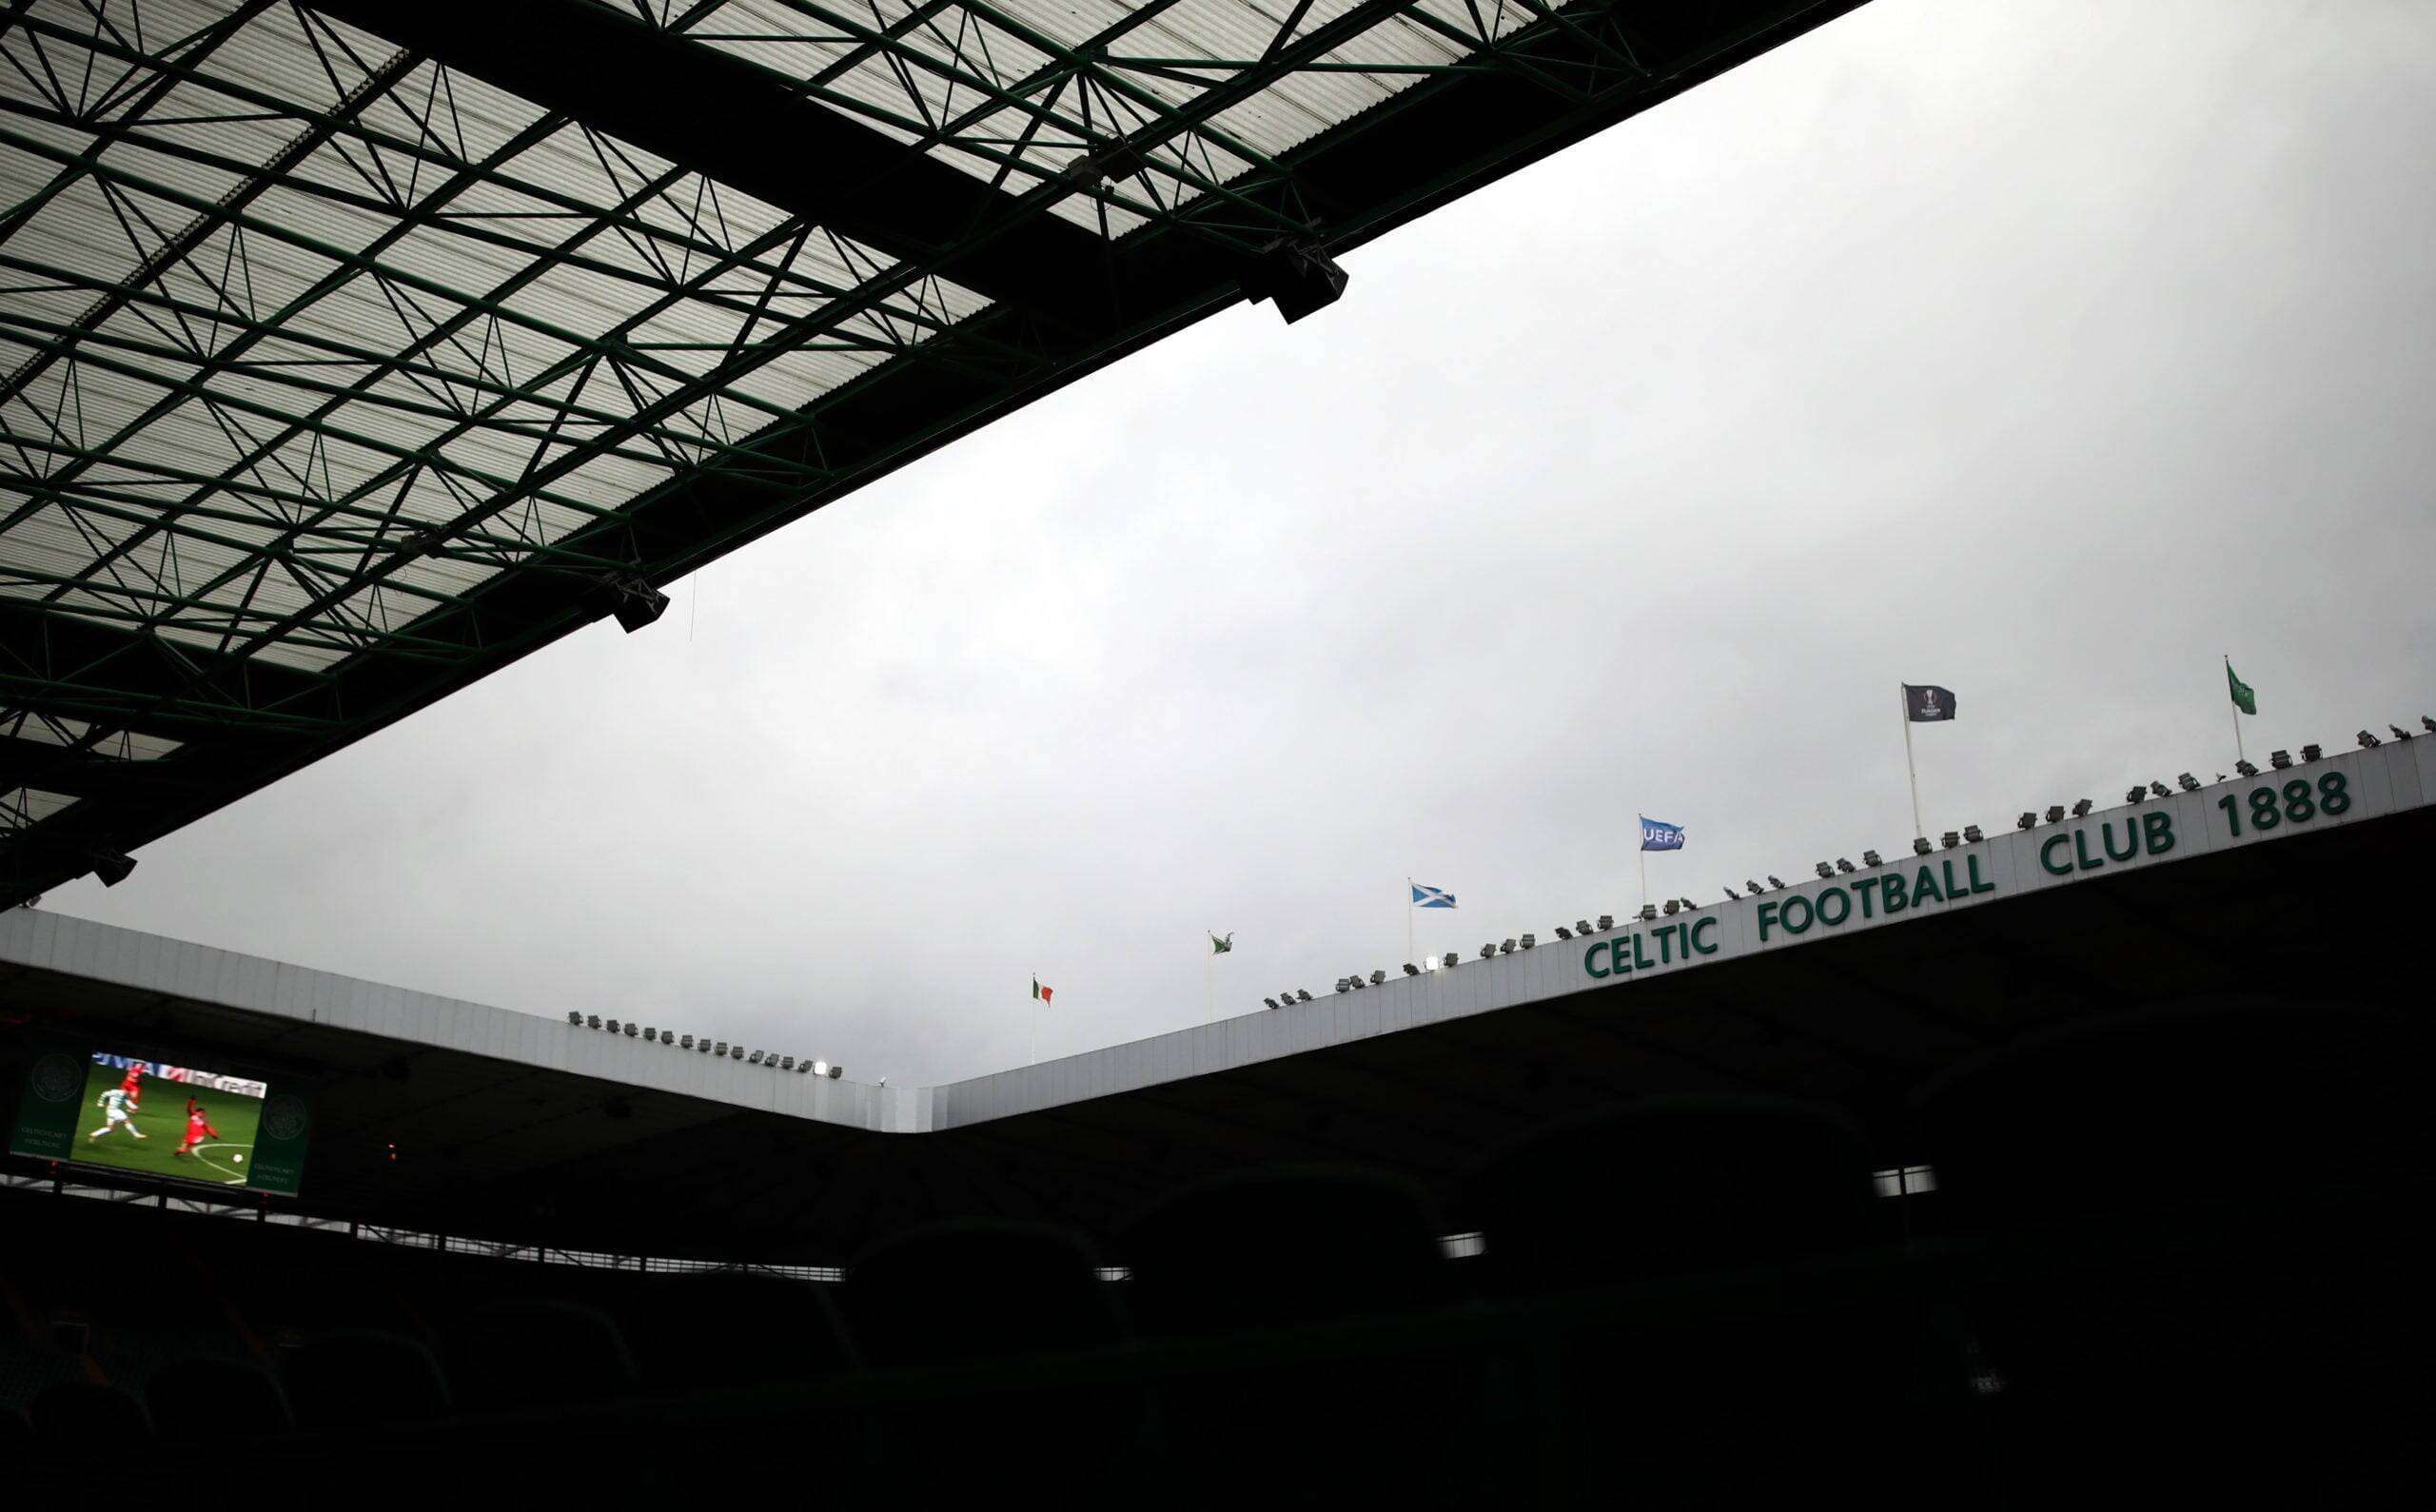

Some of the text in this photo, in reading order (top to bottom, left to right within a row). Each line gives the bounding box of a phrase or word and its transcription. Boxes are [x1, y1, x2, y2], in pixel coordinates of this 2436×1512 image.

[1583, 771, 2351, 979] CELTIC FOOTBALL CLUB 1888
[1643, 828, 1683, 843] UEFA
